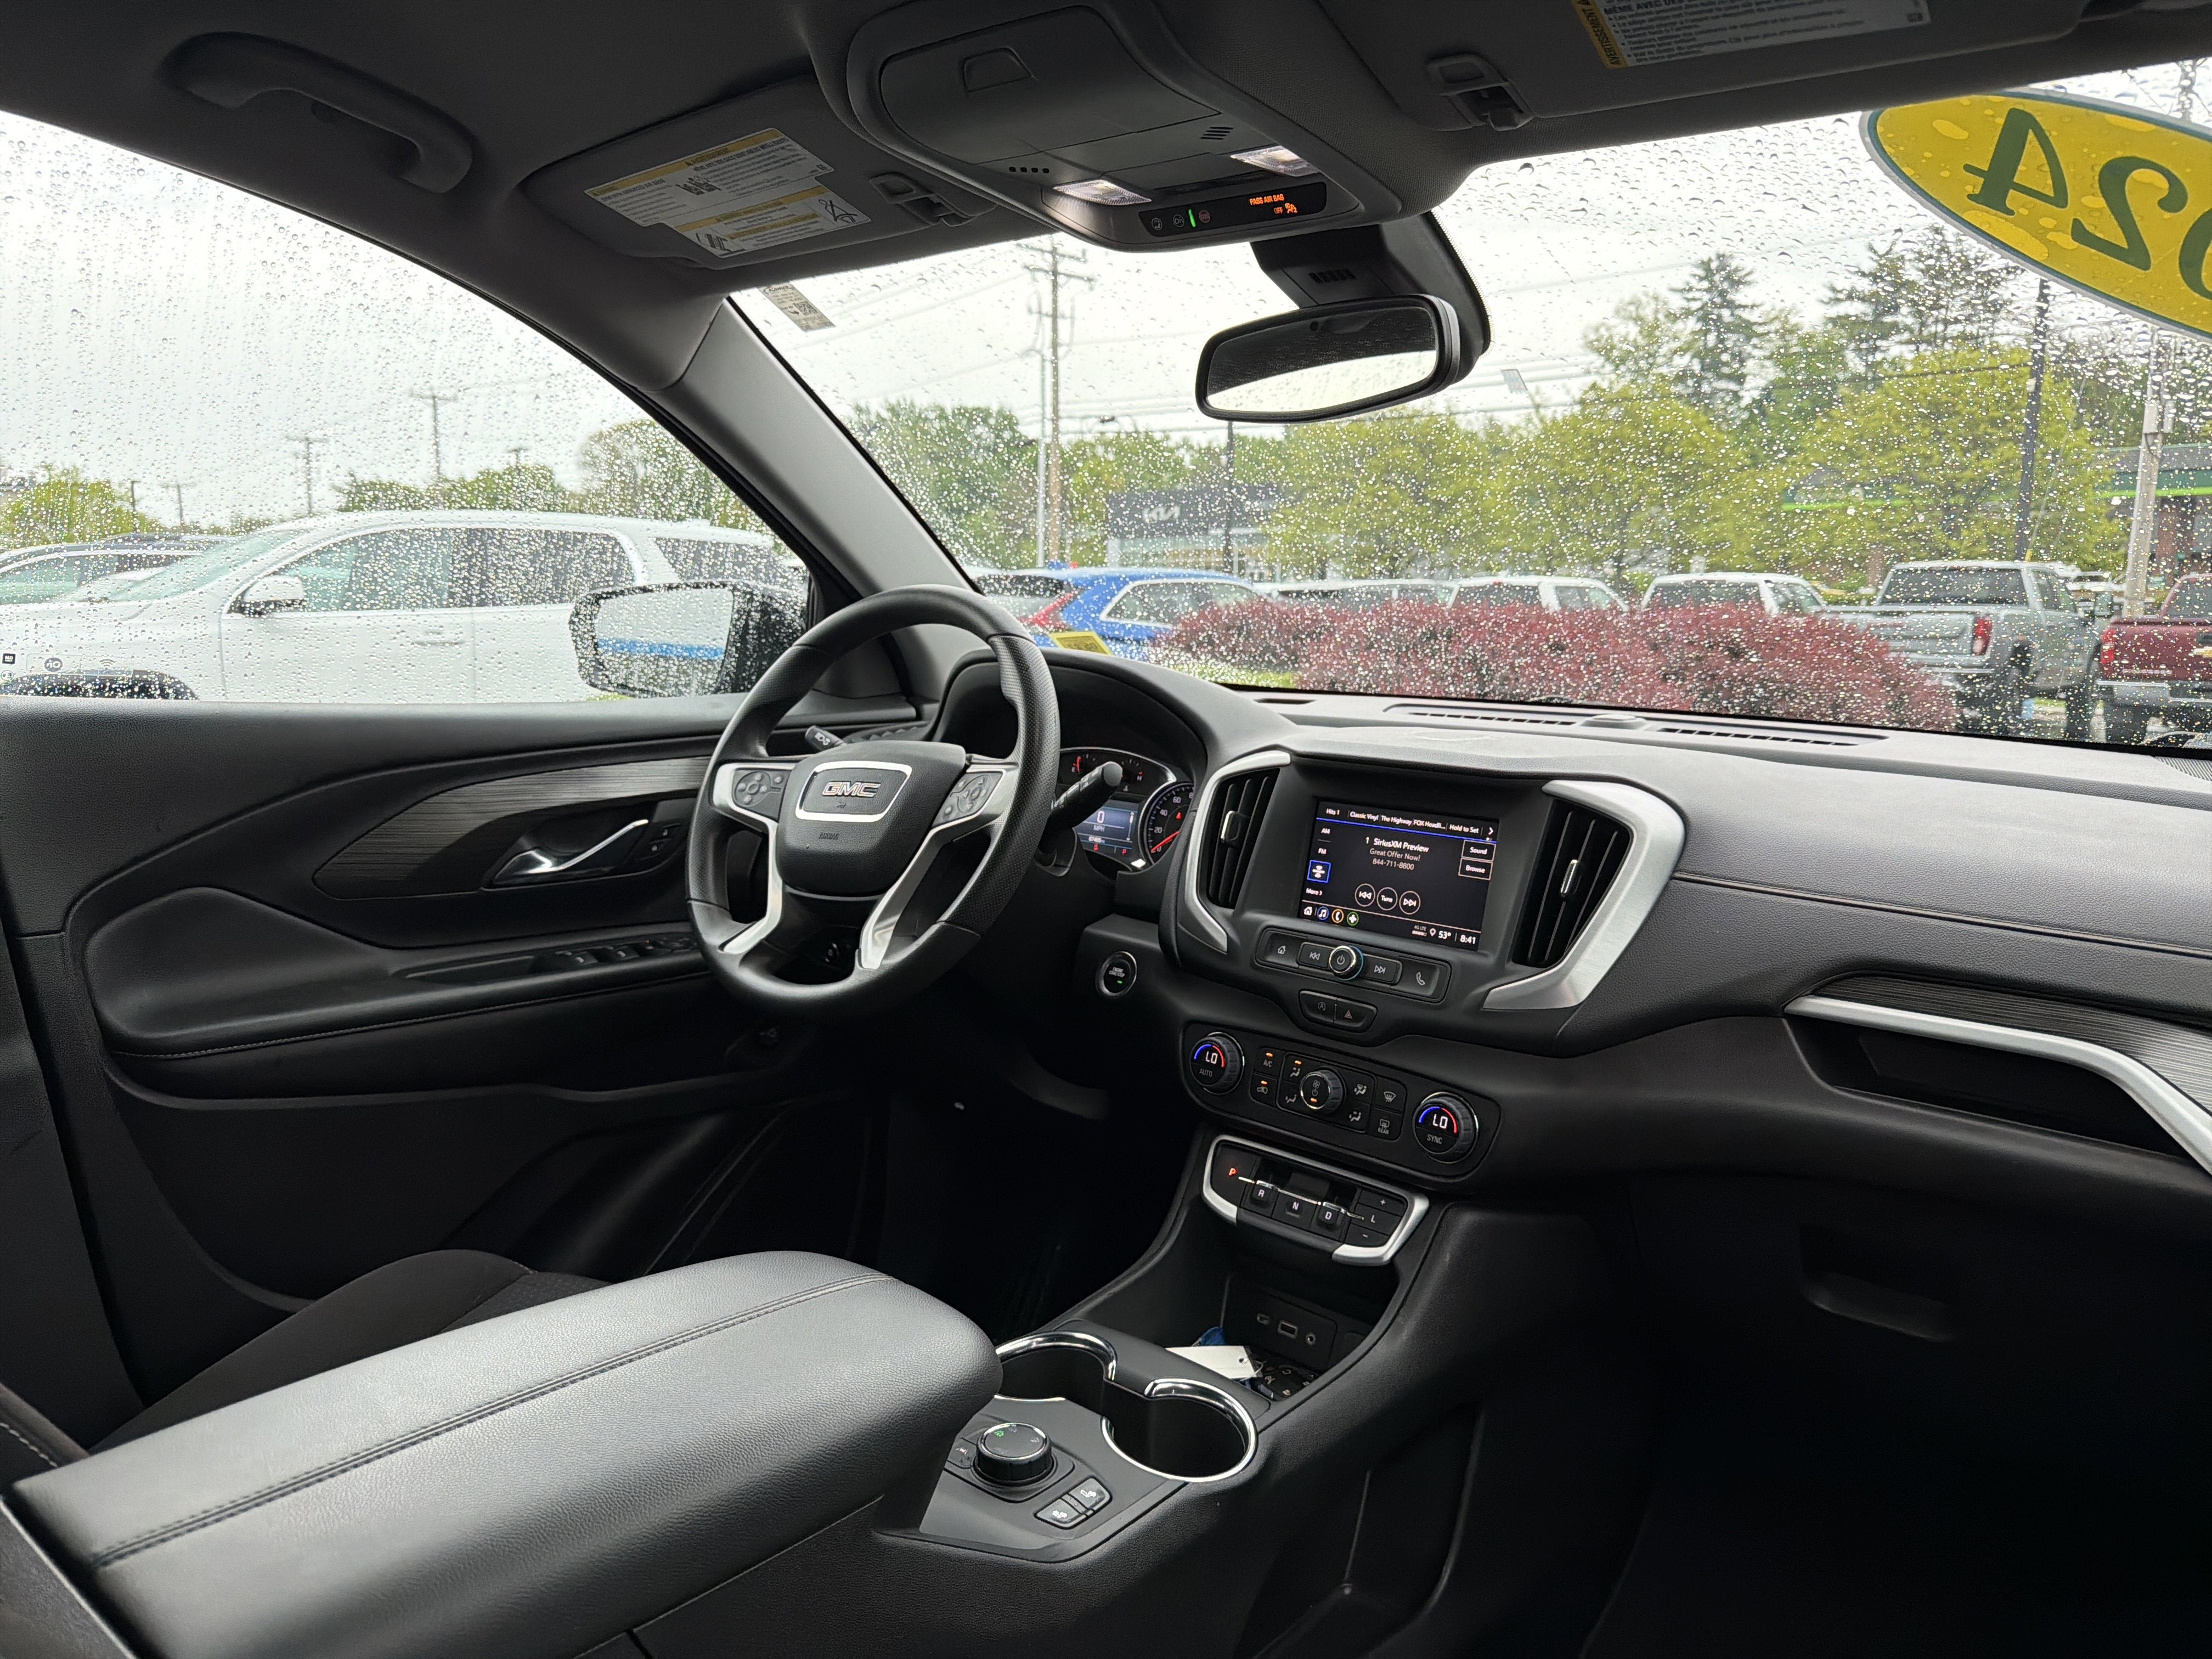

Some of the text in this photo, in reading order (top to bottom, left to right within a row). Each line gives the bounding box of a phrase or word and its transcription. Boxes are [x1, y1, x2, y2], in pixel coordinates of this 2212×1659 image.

[1249, 197, 1263, 205] PASS
[1273, 194, 1284, 202] BAG
[822, 781, 881, 798] GMC
[1097, 810, 1105, 823] 0
[1391, 816, 1412, 826] Highway
[1093, 825, 1105, 833] MPH
[1373, 838, 1402, 848] SiriusXM
[1403, 842, 1429, 853] Preview
[1369, 848, 1421, 861] Great Offer Now!
[1470, 847, 1488, 855] Sound
[1372, 857, 1414, 870] 844-711-8800
[1465, 865, 1486, 873] Browse
[1380, 895, 1393, 903] Tune
[1438, 930, 1452, 940] 53°
[1459, 934, 1476, 945] 8:41
[1205, 1050, 1218, 1064] LO
[1263, 1059, 1273, 1068] A/C
[1199, 1068, 1213, 1078] AUTO
[1432, 1114, 1448, 1129] LO
[1378, 1126, 1390, 1136] REAR
[1426, 1133, 1443, 1146] SYNC
[1228, 1167, 1238, 1177] P
[1258, 1189, 1265, 1198] R
[1292, 1201, 1300, 1211] N
[1325, 1211, 1332, 1221] D
[1370, 1214, 1376, 1223] L
